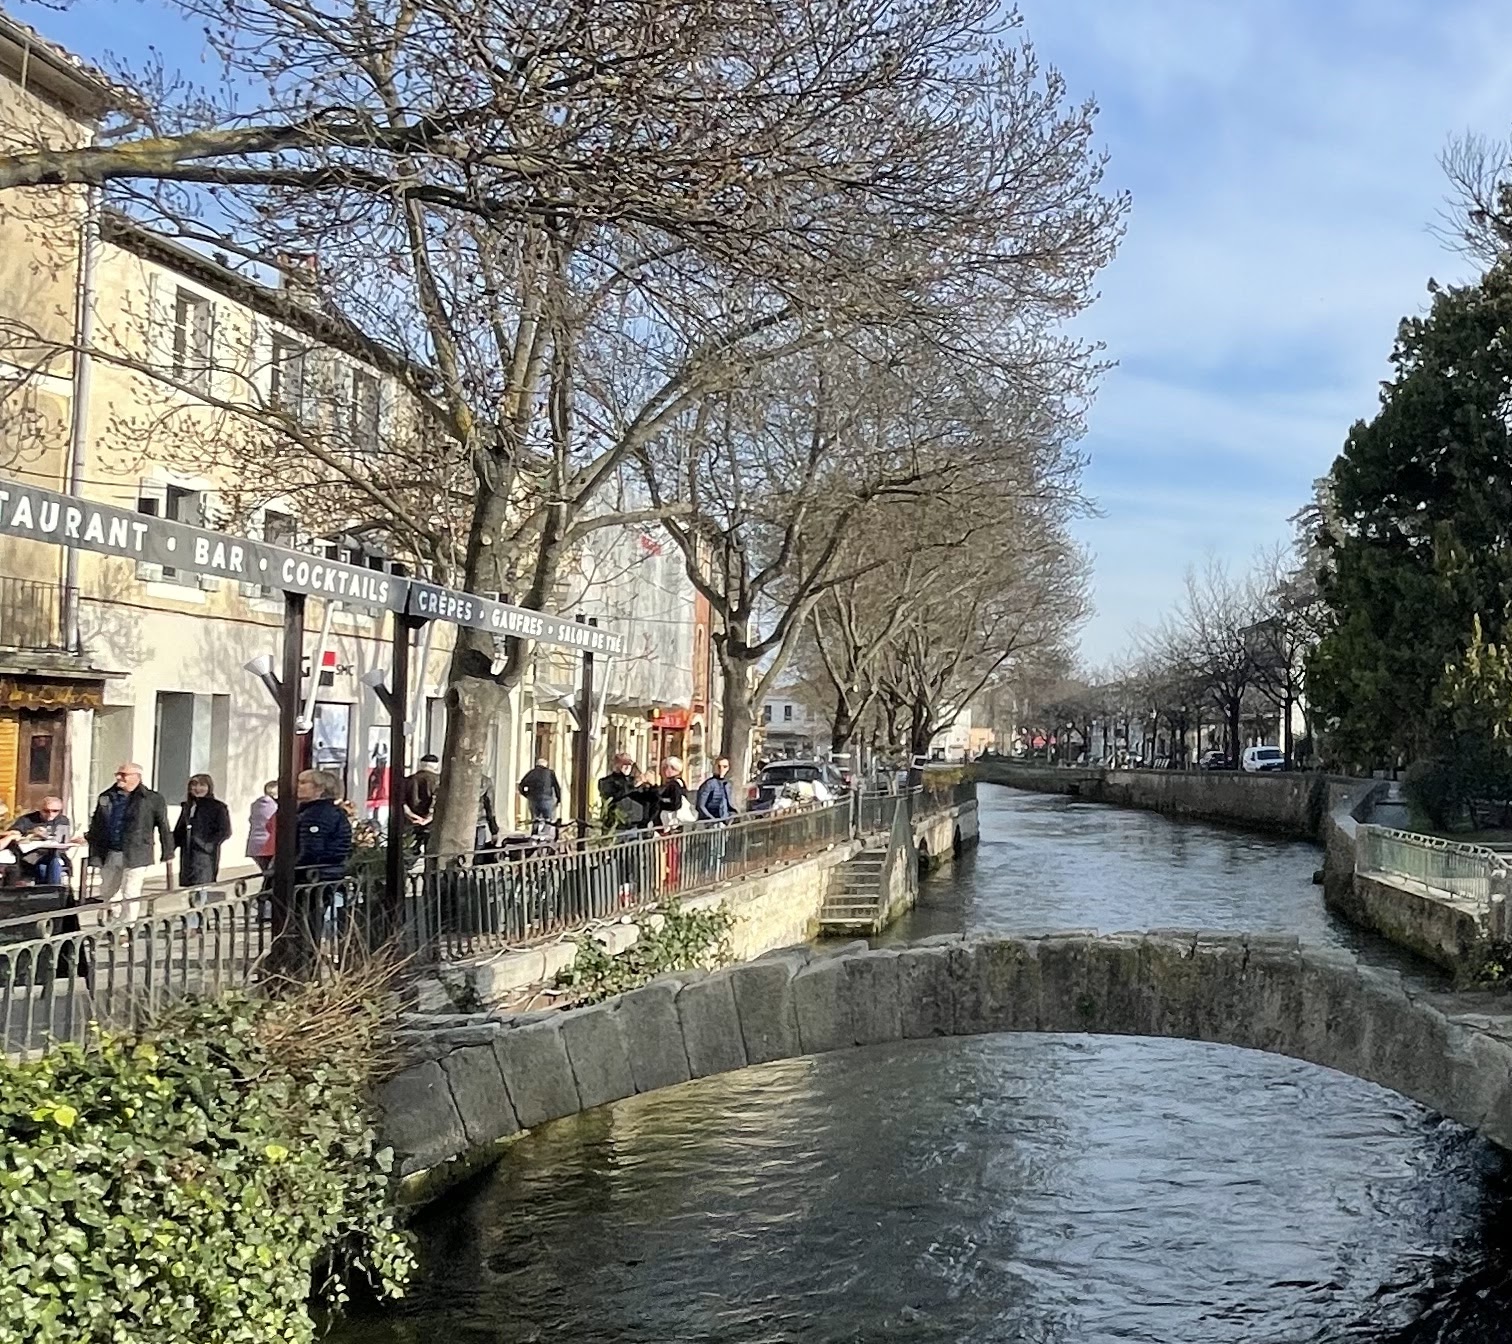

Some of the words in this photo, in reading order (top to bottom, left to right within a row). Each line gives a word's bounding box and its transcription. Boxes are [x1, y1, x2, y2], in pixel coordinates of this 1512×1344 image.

[194, 536, 244, 573] BAR
[282, 557, 389, 604] COCKTAILS
[418, 590, 473, 621] CRÊPES
[491, 608, 543, 636] GAUFRES
[557, 624, 590, 646] SALON
[591, 631, 604, 649] DE
[606, 635, 621, 653] THÉ
